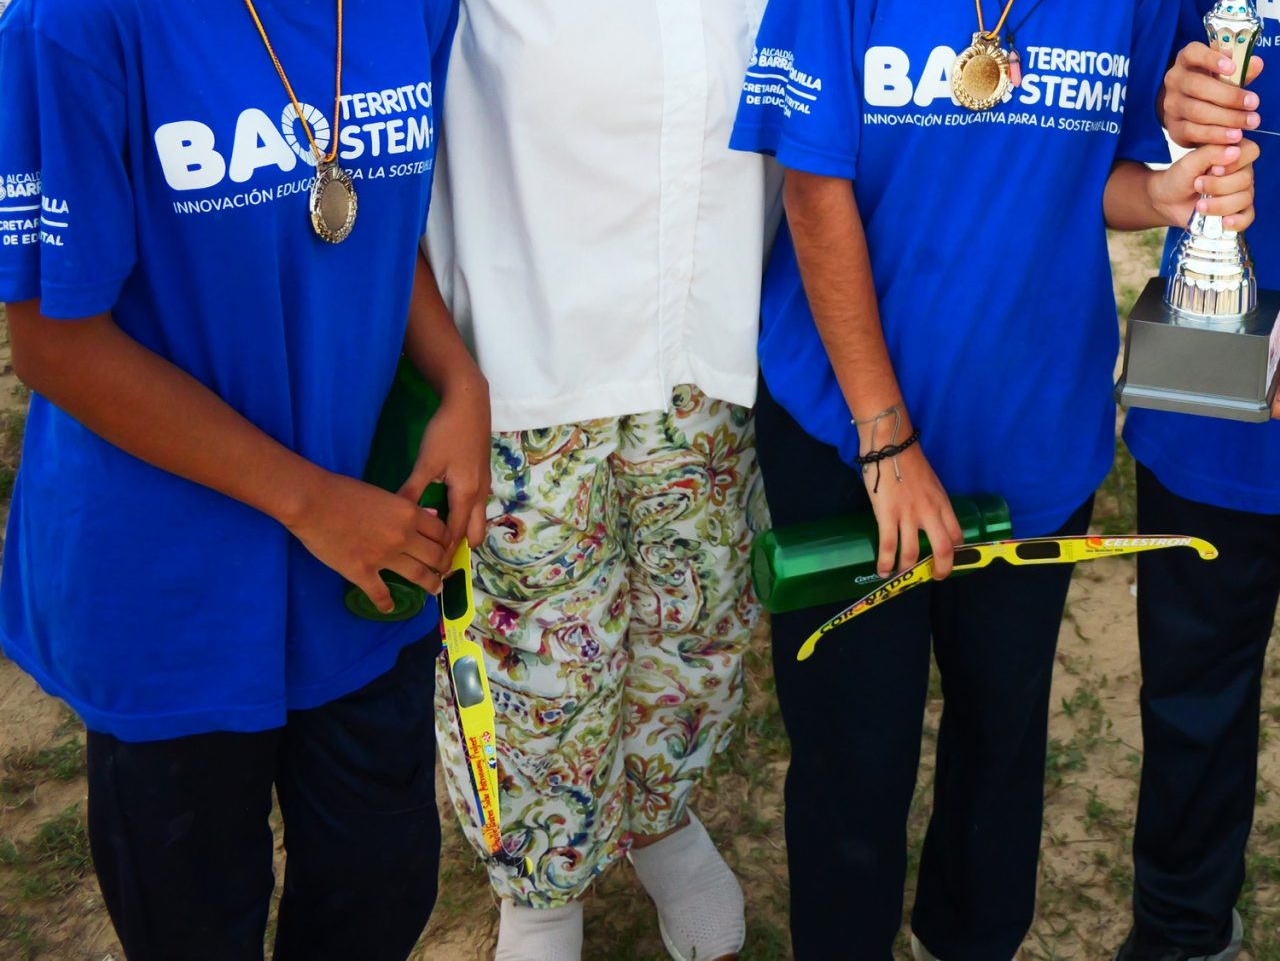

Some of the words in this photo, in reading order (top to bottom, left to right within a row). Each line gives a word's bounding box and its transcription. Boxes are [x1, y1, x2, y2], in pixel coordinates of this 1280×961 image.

[338, 81, 433, 121] TERRITO
[746, 94, 761, 105] DE
[863, 112, 942, 127] INNOVACIÓN
[944, 111, 1006, 126] EDUCATIVA
[1007, 111, 1038, 126] PARA
[1040, 115, 1055, 128] LA
[368, 165, 386, 179] LA
[173, 188, 274, 214] INNOVACIÓN
[3, 234, 19, 246] DE
[1104, 537, 1192, 548] CELESTRON
[469, 736, 481, 760] Project
